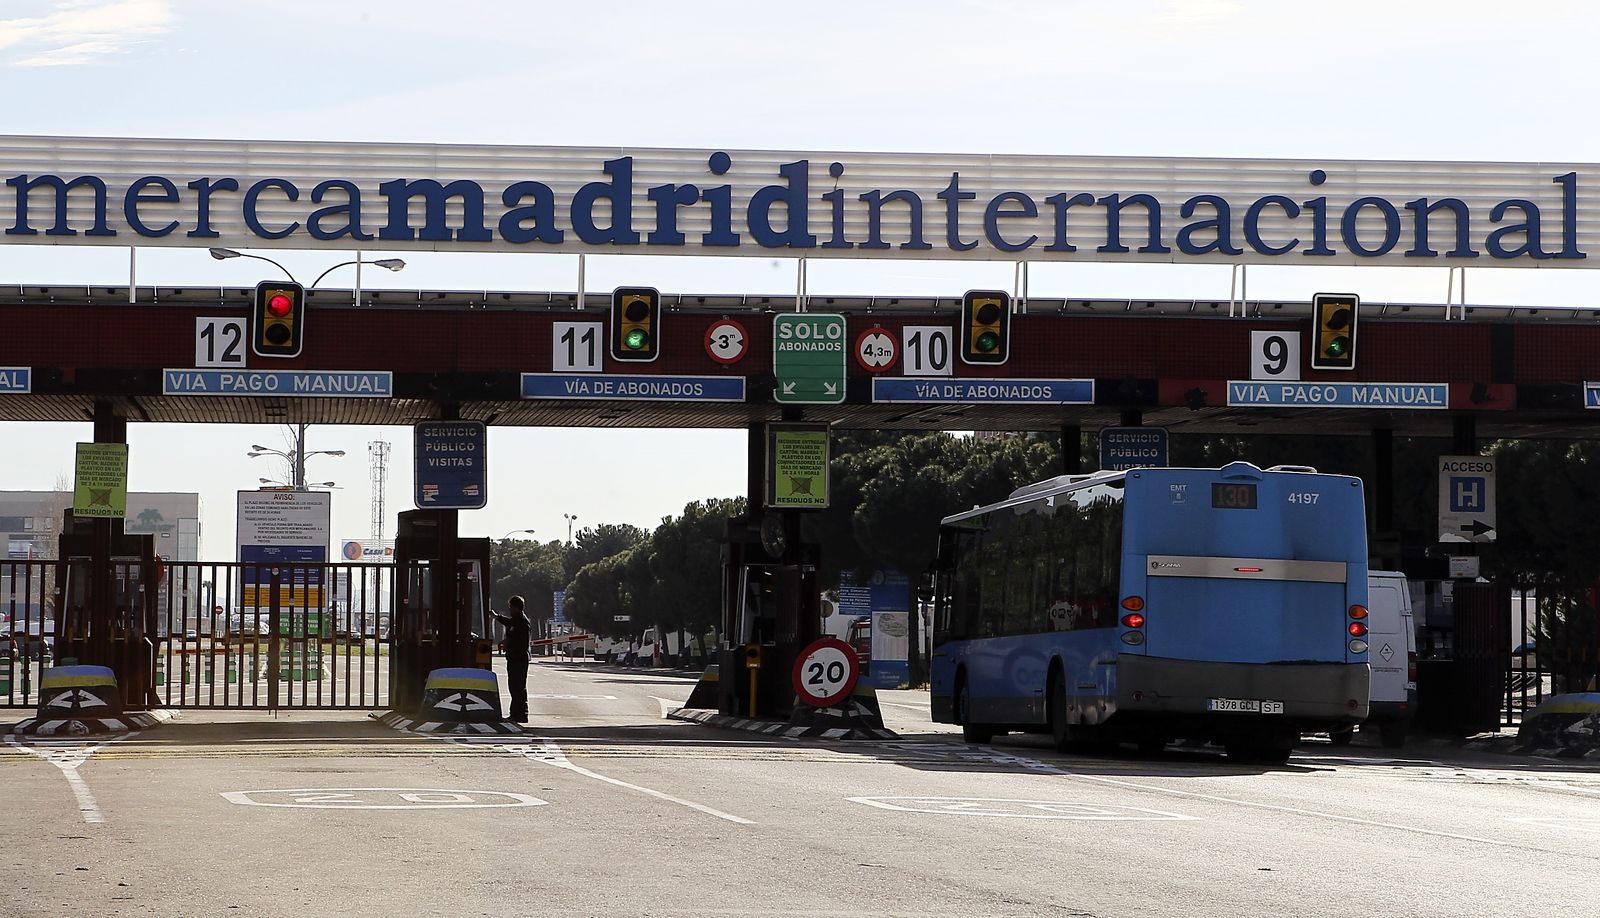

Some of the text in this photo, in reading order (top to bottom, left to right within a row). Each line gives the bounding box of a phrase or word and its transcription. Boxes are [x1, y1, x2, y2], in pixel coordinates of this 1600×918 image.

[778, 322, 842, 340] SOLO
[201, 322, 242, 362] 12
[561, 326, 595, 367] 11
[778, 342, 842, 351] ABONADOS
[863, 344, 891, 357] 4,3m
[907, 331, 948, 371] 10
[1262, 335, 1289, 375] 9
[0, 371, 24, 388] AL
[169, 373, 386, 392] VIA PAGO MANUAL
[565, 378, 703, 396] VÍA DE ABONADOS
[915, 382, 1052, 399] VÍA DE ABONADOS
[1234, 385, 1442, 404] VIA PAGO MANUAL
[424, 428, 477, 437] SERVICIO
[1108, 434, 1160, 443] SERVICIO
[425, 440, 475, 452] PÚBLICO
[1110, 446, 1158, 457] PÚBLICO
[428, 457, 473, 467] VISITAS
[1442, 461, 1493, 472] ACCESO
[1170, 484, 1186, 492] EMT
[1216, 485, 1250, 507] 130
[1457, 482, 1478, 507] H
[1288, 492, 1320, 505] 4197
[808, 661, 845, 685] 20
[1215, 701, 1257, 710] 1378 GCL
[1264, 703, 1280, 712] SP
